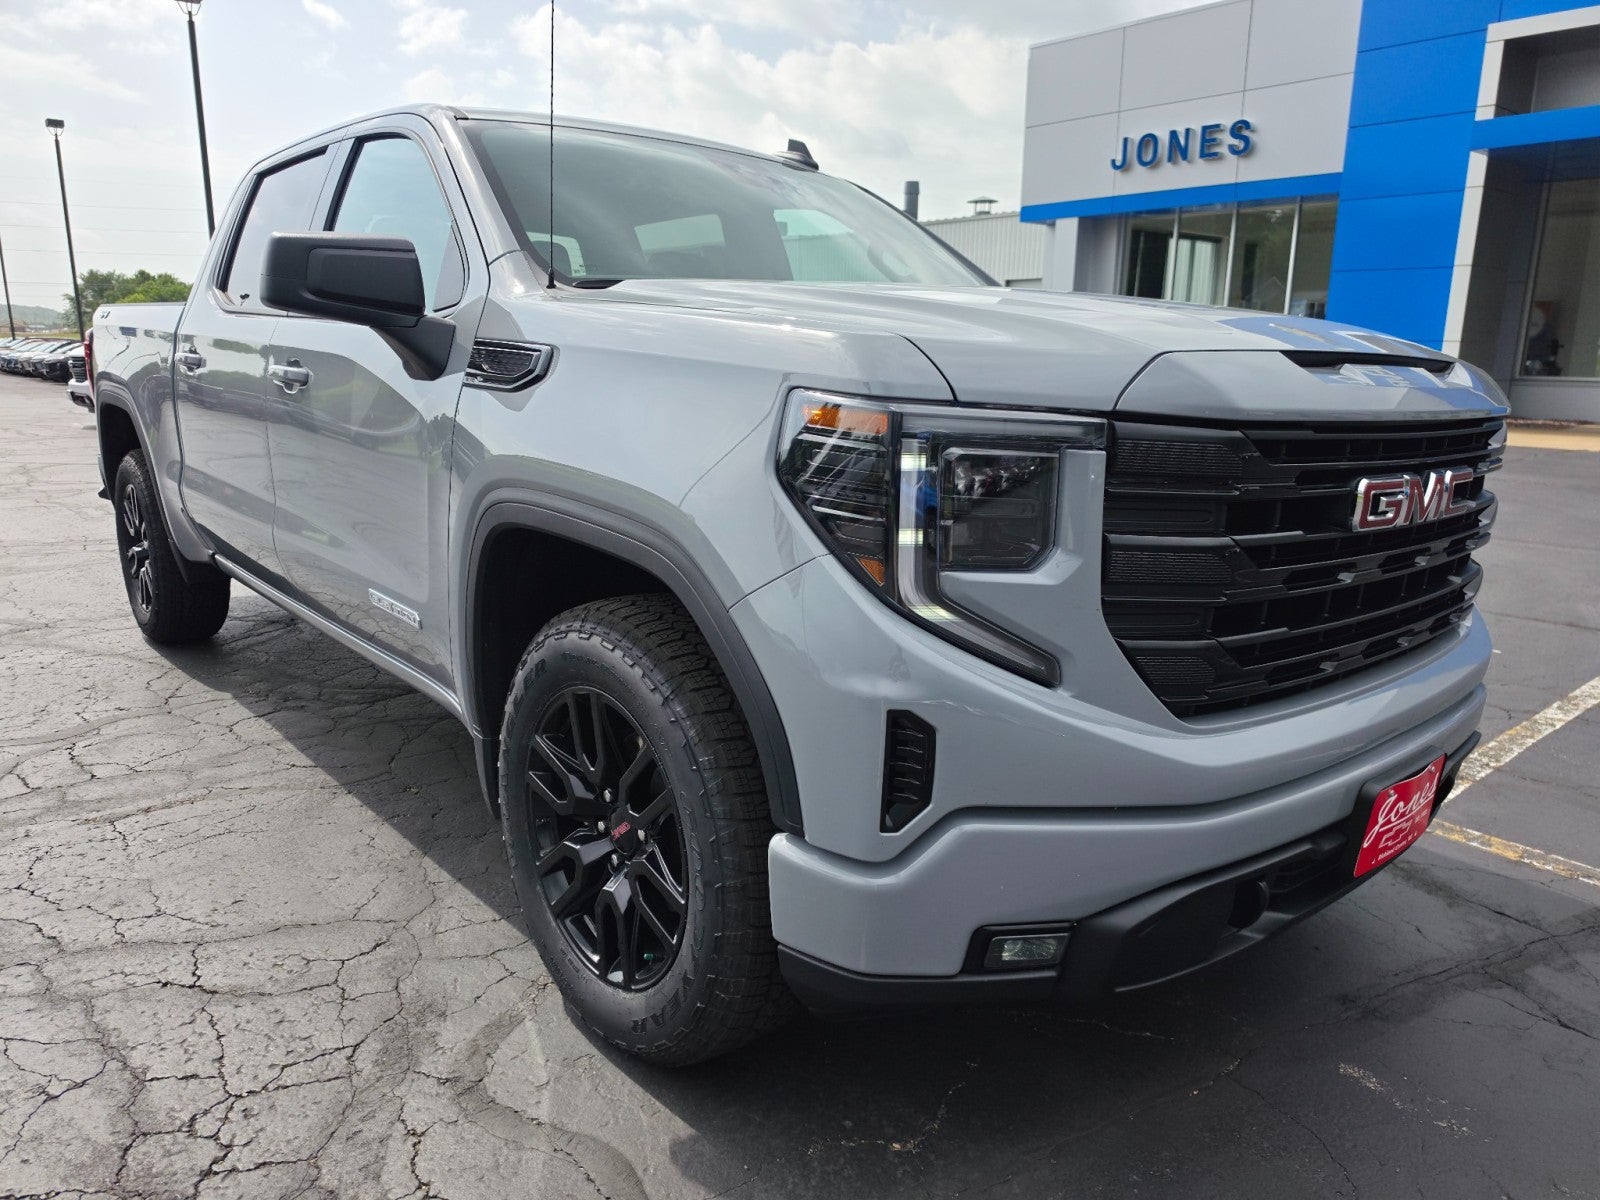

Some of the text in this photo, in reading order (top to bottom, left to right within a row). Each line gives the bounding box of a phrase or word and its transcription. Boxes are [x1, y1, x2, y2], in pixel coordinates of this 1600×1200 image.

[1110, 118, 1254, 171] JONES
[1352, 467, 1474, 532] GMC
[1362, 771, 1440, 848] Jones
